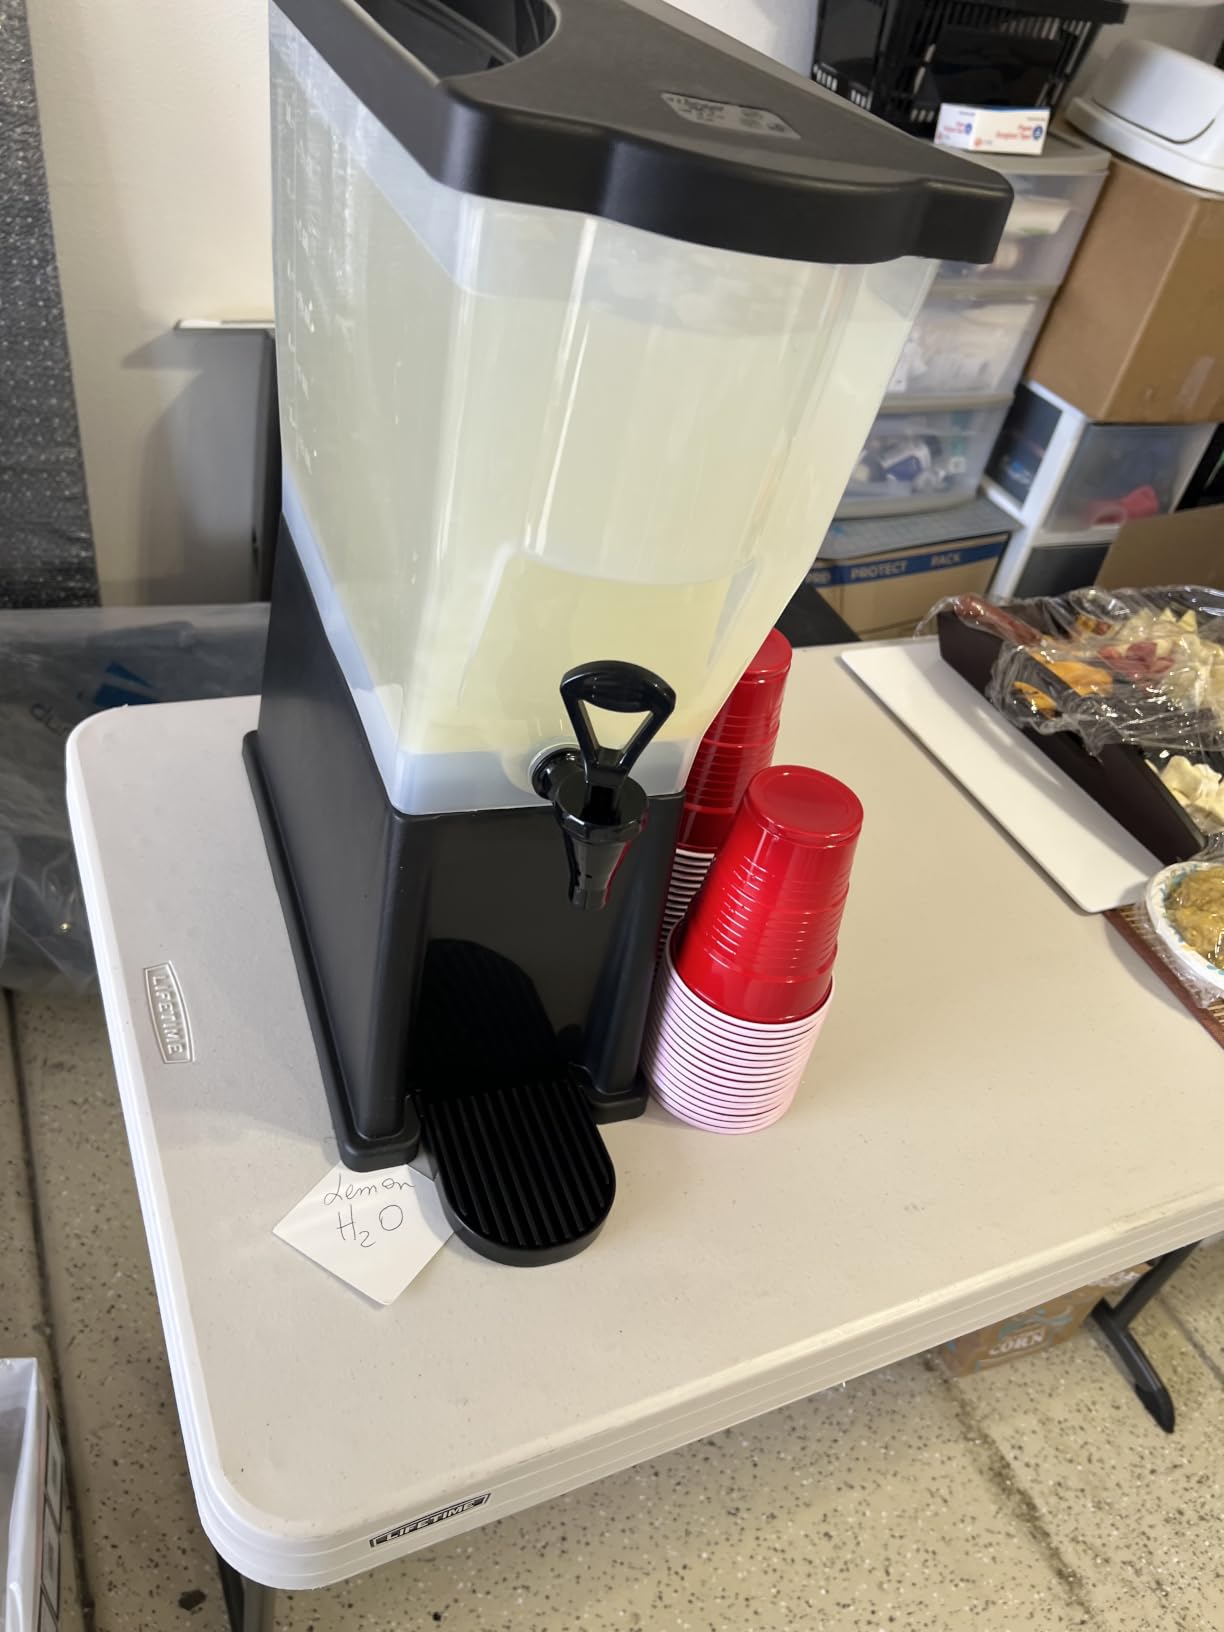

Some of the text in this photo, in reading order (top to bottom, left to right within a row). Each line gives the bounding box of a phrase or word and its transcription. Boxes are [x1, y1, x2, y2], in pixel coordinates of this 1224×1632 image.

[850, 559, 909, 580] PROTECT
[930, 552, 962, 568] PACK
[152, 973, 184, 1056] LIFETIME
[323, 1172, 416, 1206] Lemon
[336, 1203, 404, 1248] H2O
[988, 1326, 1046, 1356] CORN
[385, 1499, 476, 1542] LIFETIME
